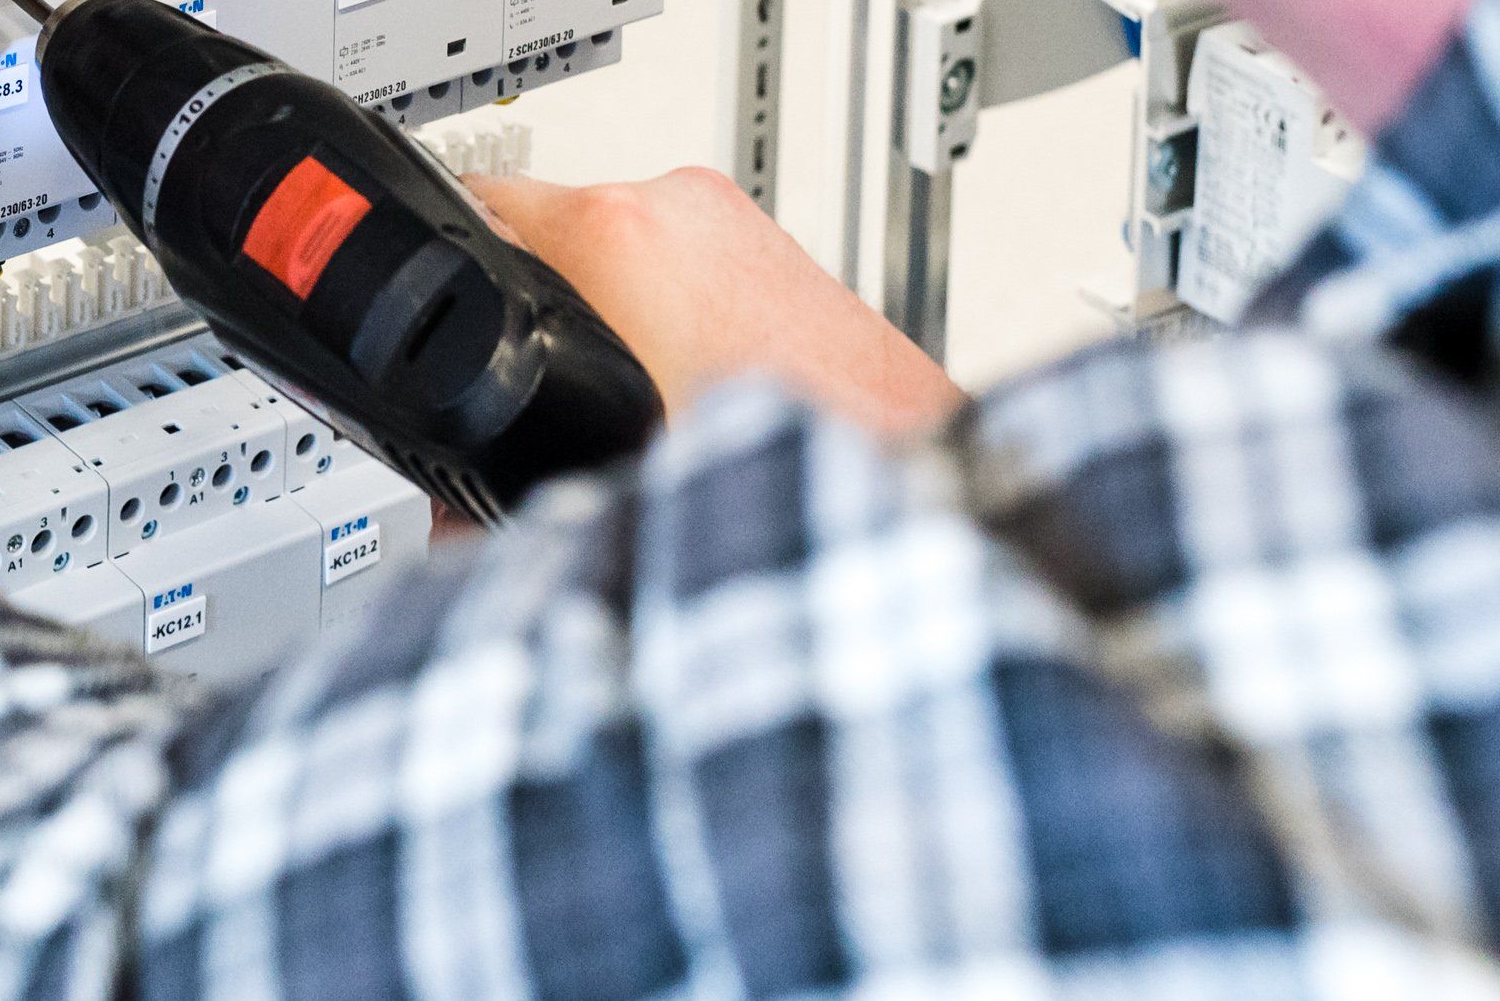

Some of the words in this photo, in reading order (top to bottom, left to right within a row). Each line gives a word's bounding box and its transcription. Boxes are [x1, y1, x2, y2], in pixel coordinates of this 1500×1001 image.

[564, 62, 570, 72] 4
[516, 76, 523, 88] 2
[179, 99, 204, 124] 10
[47, 228, 54, 238] 4
[220, 452, 228, 463] 3
[170, 471, 175, 481] 1
[189, 492, 204, 506] A1
[40, 518, 48, 530] 3
[330, 540, 378, 570] -KC12.2
[7, 558, 24, 573] A1
[152, 611, 202, 640] -KC12.1
